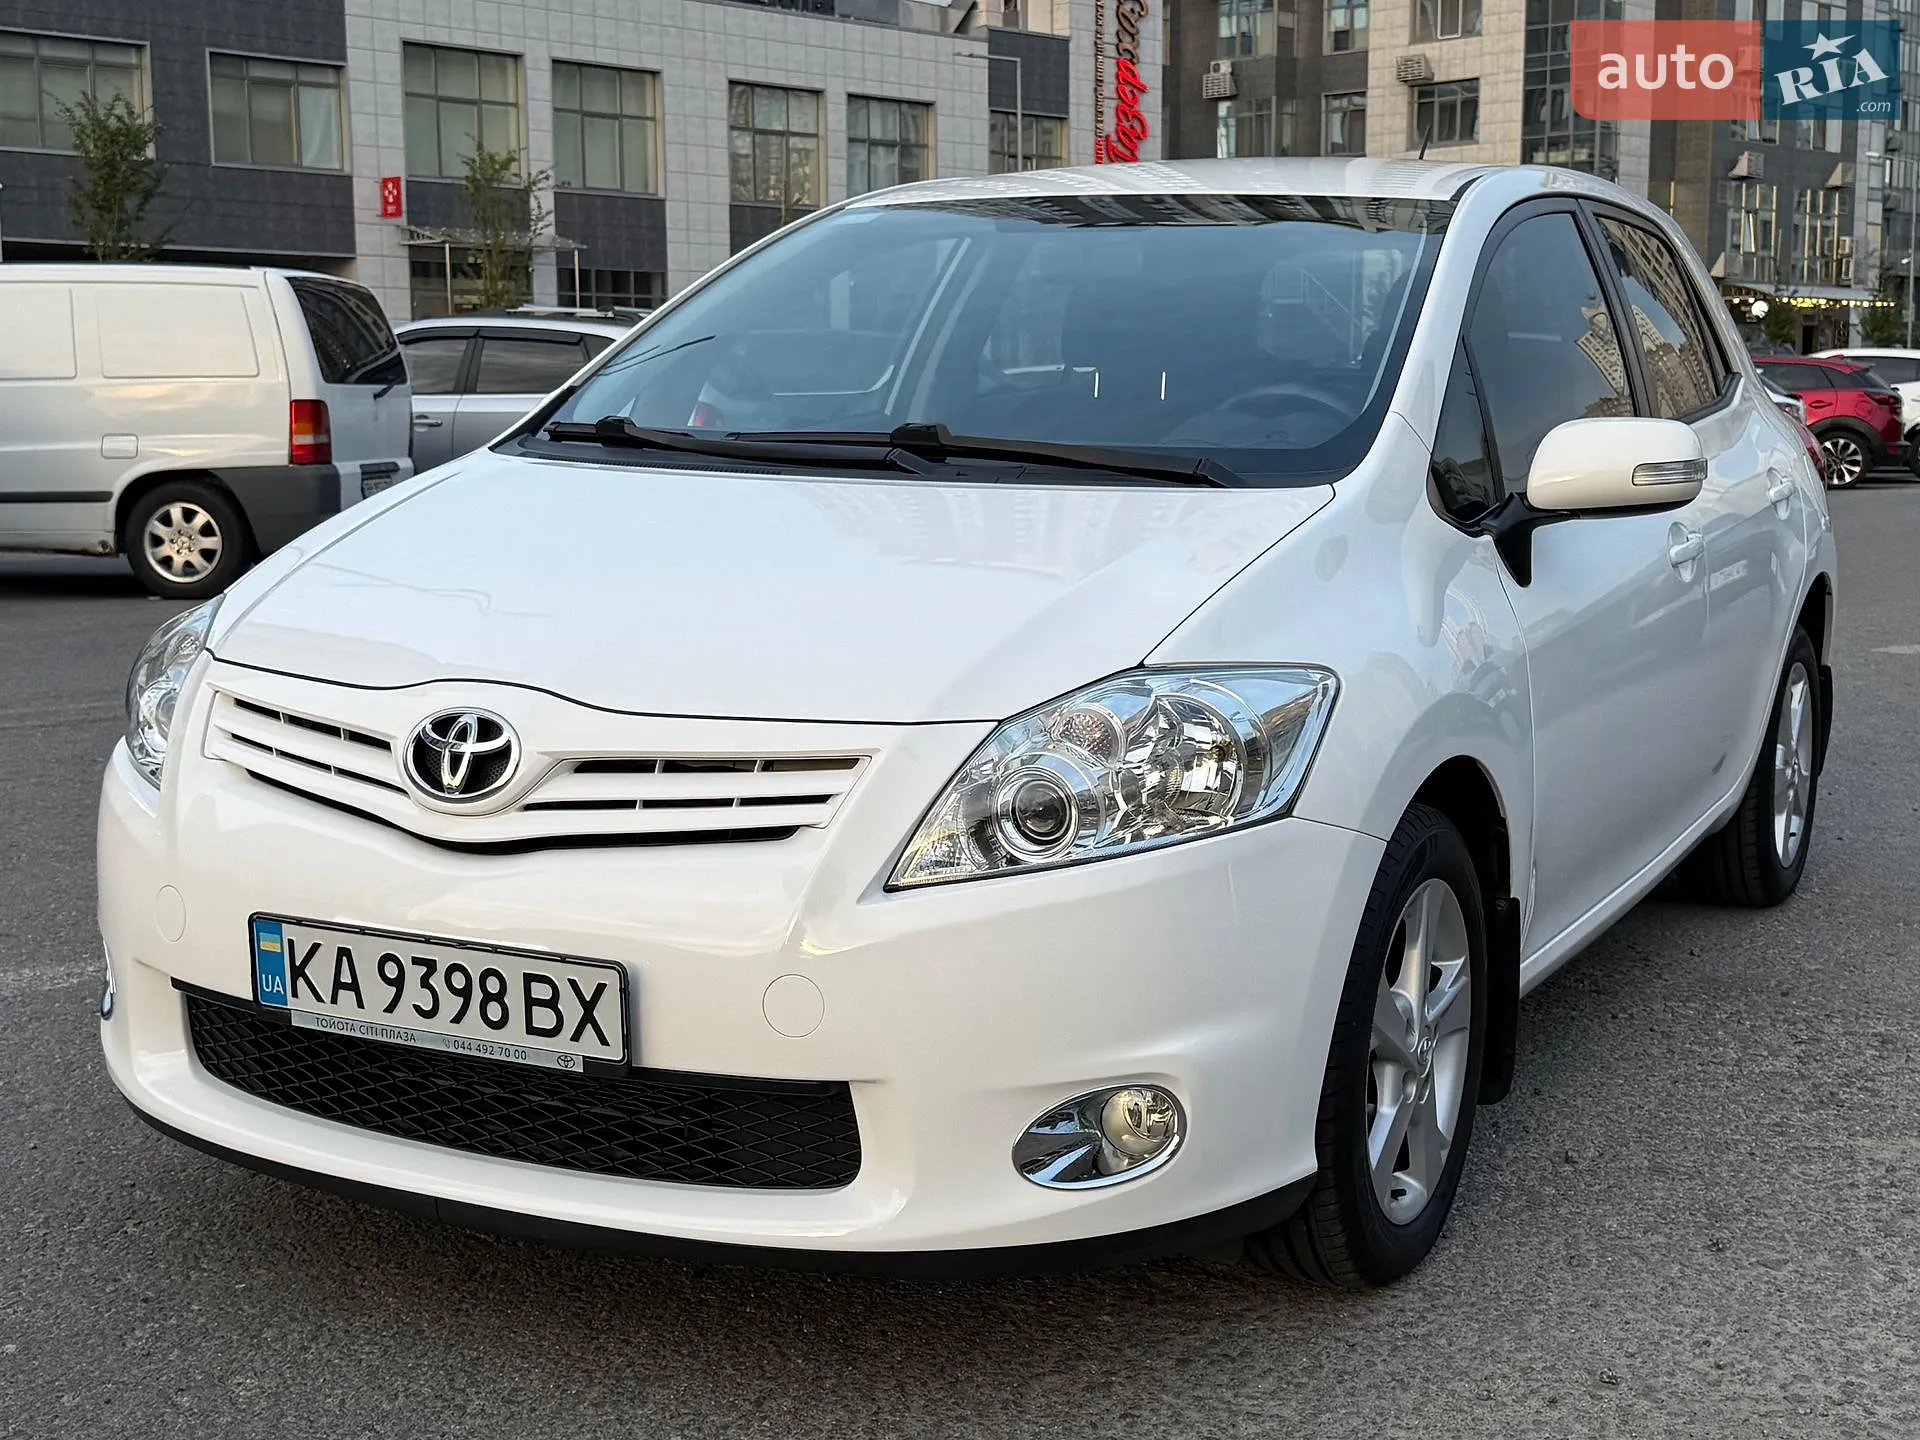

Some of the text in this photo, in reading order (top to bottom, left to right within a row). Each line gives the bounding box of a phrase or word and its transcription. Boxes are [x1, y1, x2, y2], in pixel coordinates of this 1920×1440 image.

[262, 974, 284, 995] UA
[315, 1017, 527, 1061] ТОЙОТА СІТІ ПЛАЗА 044 492 70 00
